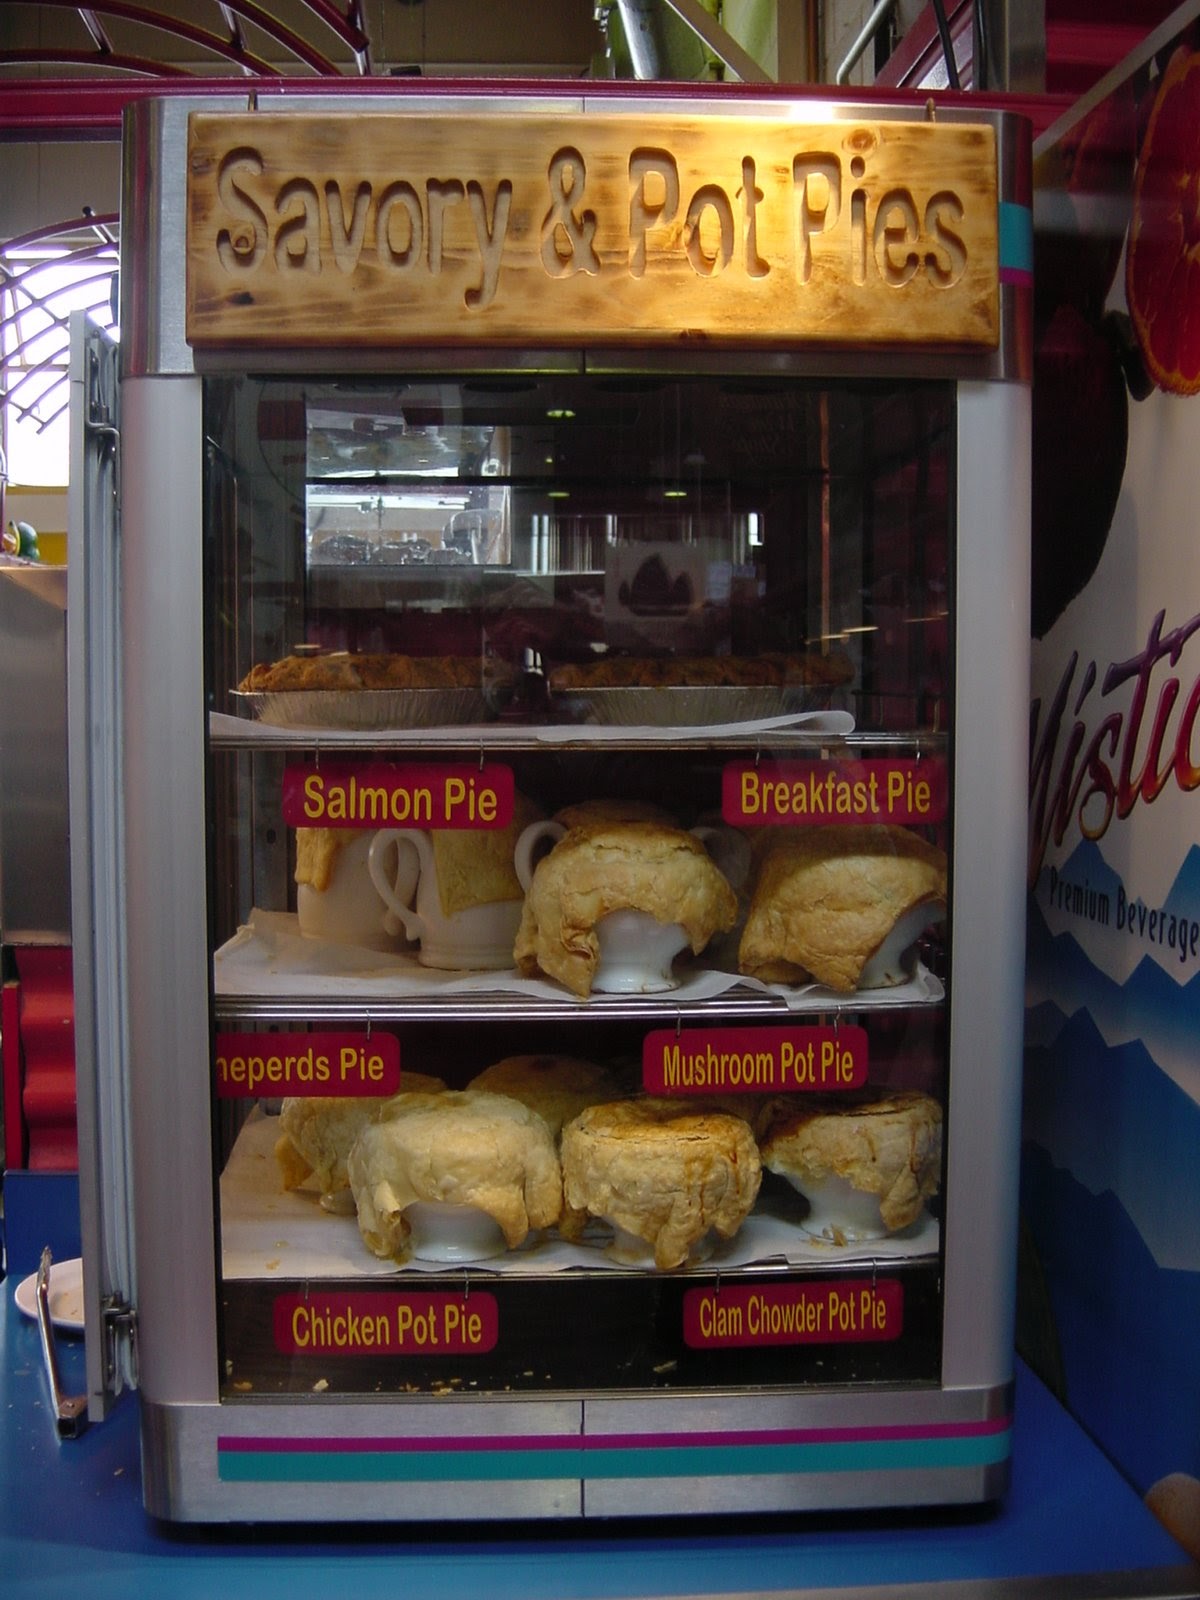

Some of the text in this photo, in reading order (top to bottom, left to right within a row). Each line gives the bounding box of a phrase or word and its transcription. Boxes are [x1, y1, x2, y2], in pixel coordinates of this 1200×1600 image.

[216, 146, 968, 312] Savory & Pot Pies
[304, 774, 498, 821] Salmon Pie
[741, 771, 930, 814] Breakfast Pie
[1050, 866, 1110, 926] Premium
[340, 1048, 384, 1081] Pie
[663, 1041, 854, 1086] Mushroom Pot Pie
[292, 1304, 482, 1347] Chicken Pot Pie
[700, 1290, 887, 1338] Clam Chowder Pot Pie
